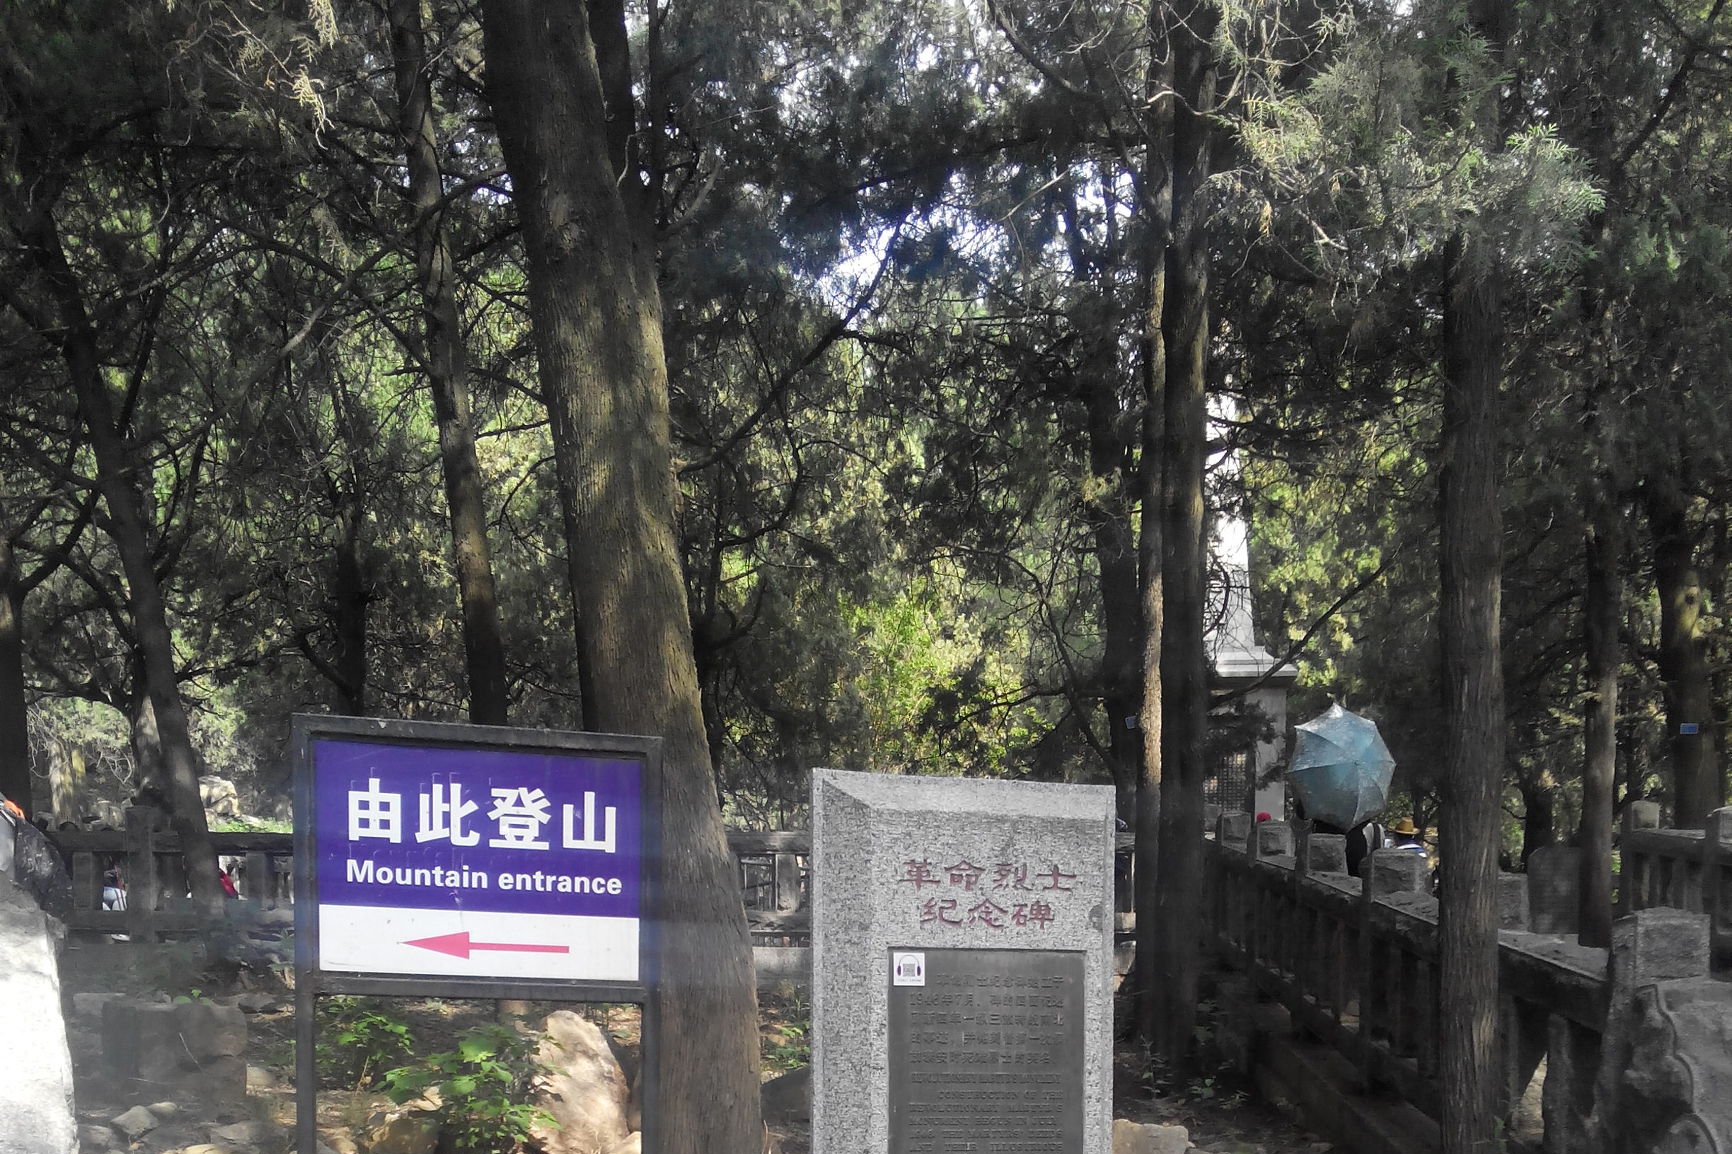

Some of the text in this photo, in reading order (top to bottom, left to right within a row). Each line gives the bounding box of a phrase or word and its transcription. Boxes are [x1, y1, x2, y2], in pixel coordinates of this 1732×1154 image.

[348, 777, 617, 854] 由此登山
[346, 859, 623, 895] Mountain entrance
[898, 856, 1077, 893] 革命烈士
[919, 896, 1055, 930] 纪念碑
